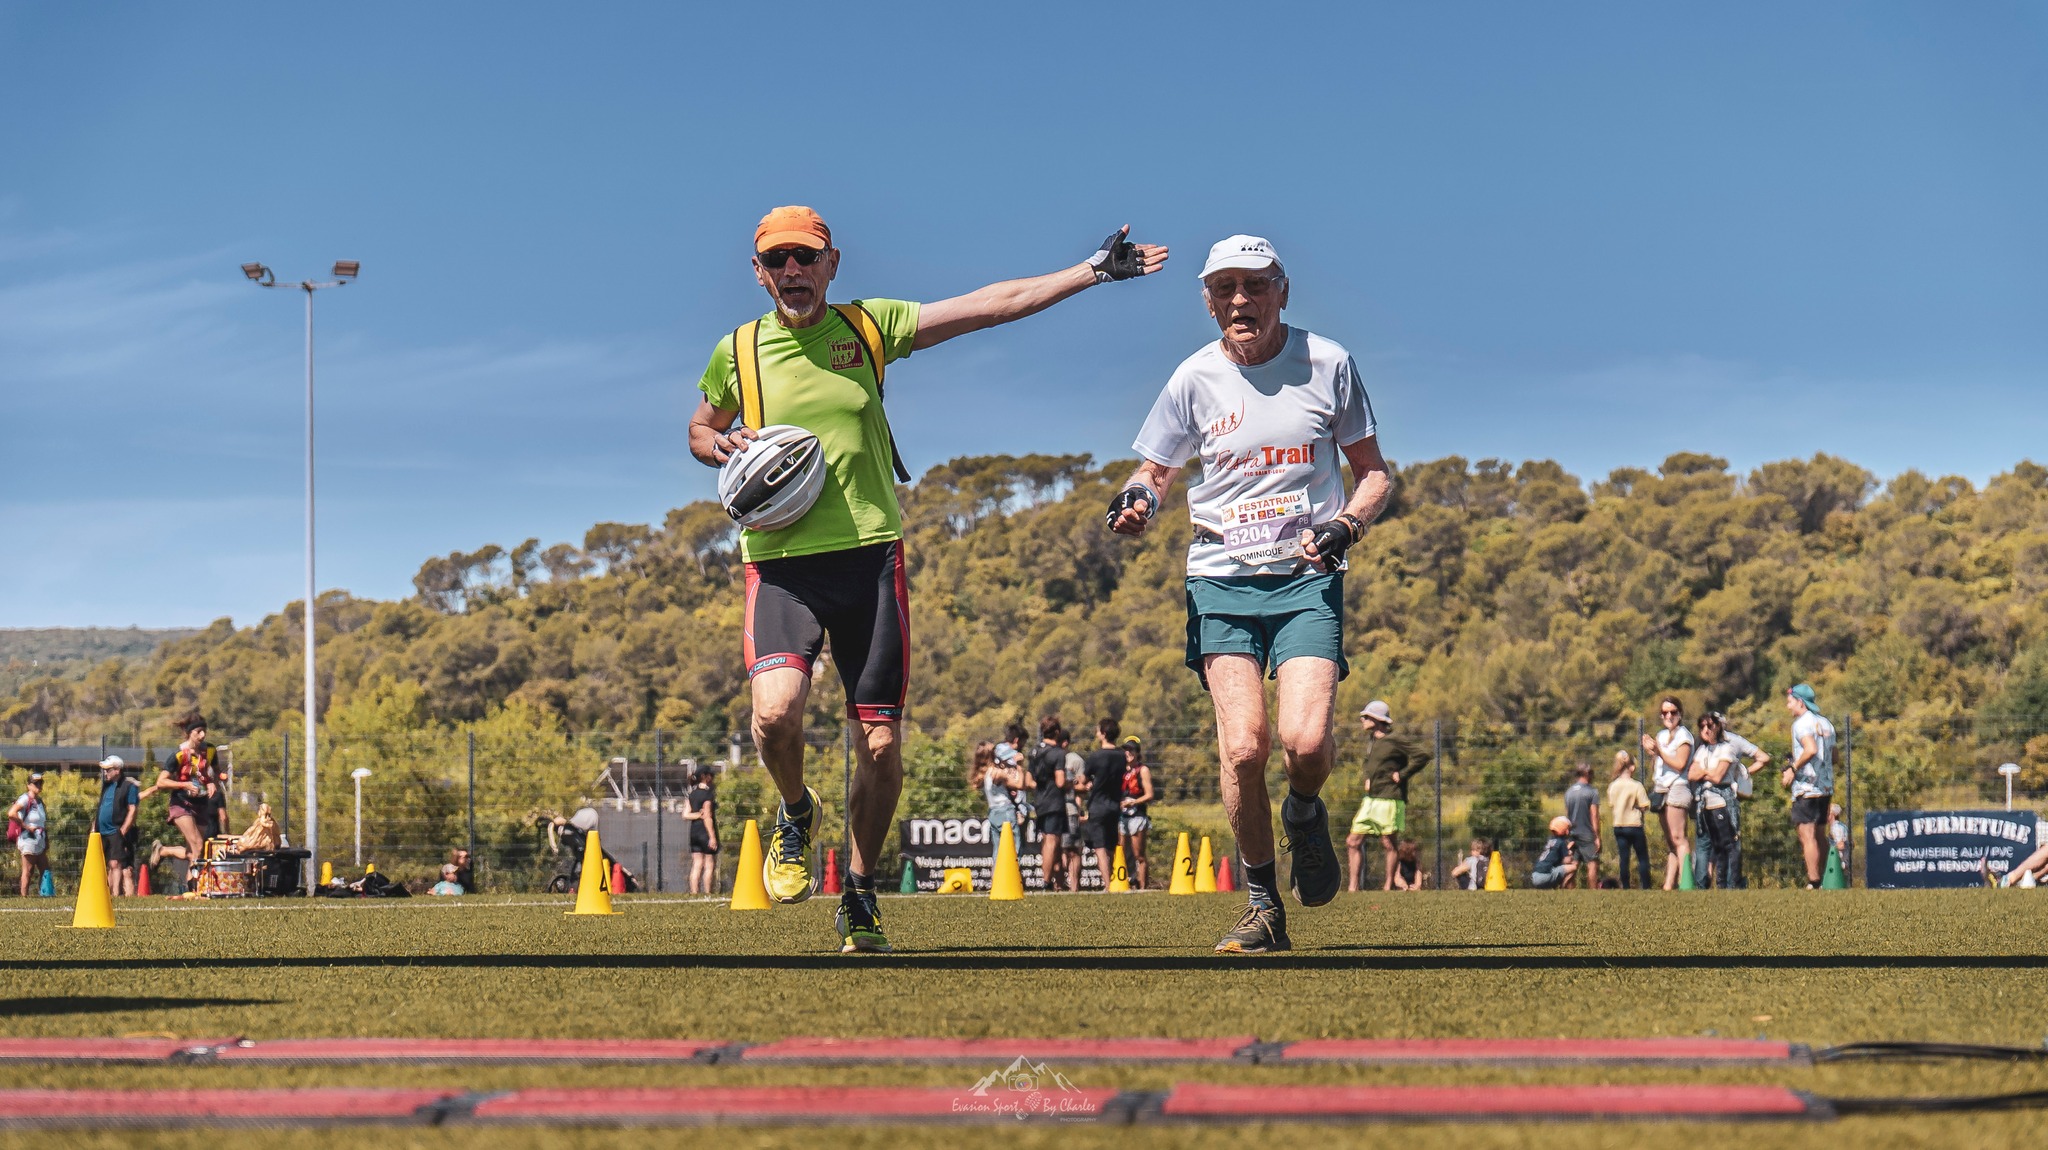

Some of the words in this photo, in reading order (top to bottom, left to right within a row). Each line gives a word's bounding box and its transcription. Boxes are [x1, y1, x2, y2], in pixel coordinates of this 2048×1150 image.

[1260, 443, 1316, 467] Trail
[1229, 524, 1272, 547] 5204
[1233, 546, 1284, 562] DOMINIQUE
[1912, 815, 2032, 845] FERMETURE
[1889, 847, 1958, 859] MENUISERIE
[1960, 847, 1983, 859] ALU
[1990, 847, 2014, 858] PVC
[943, 855, 995, 869] équipemen
[1182, 857, 1194, 876] 2
[1894, 860, 1926, 873] NEUF
